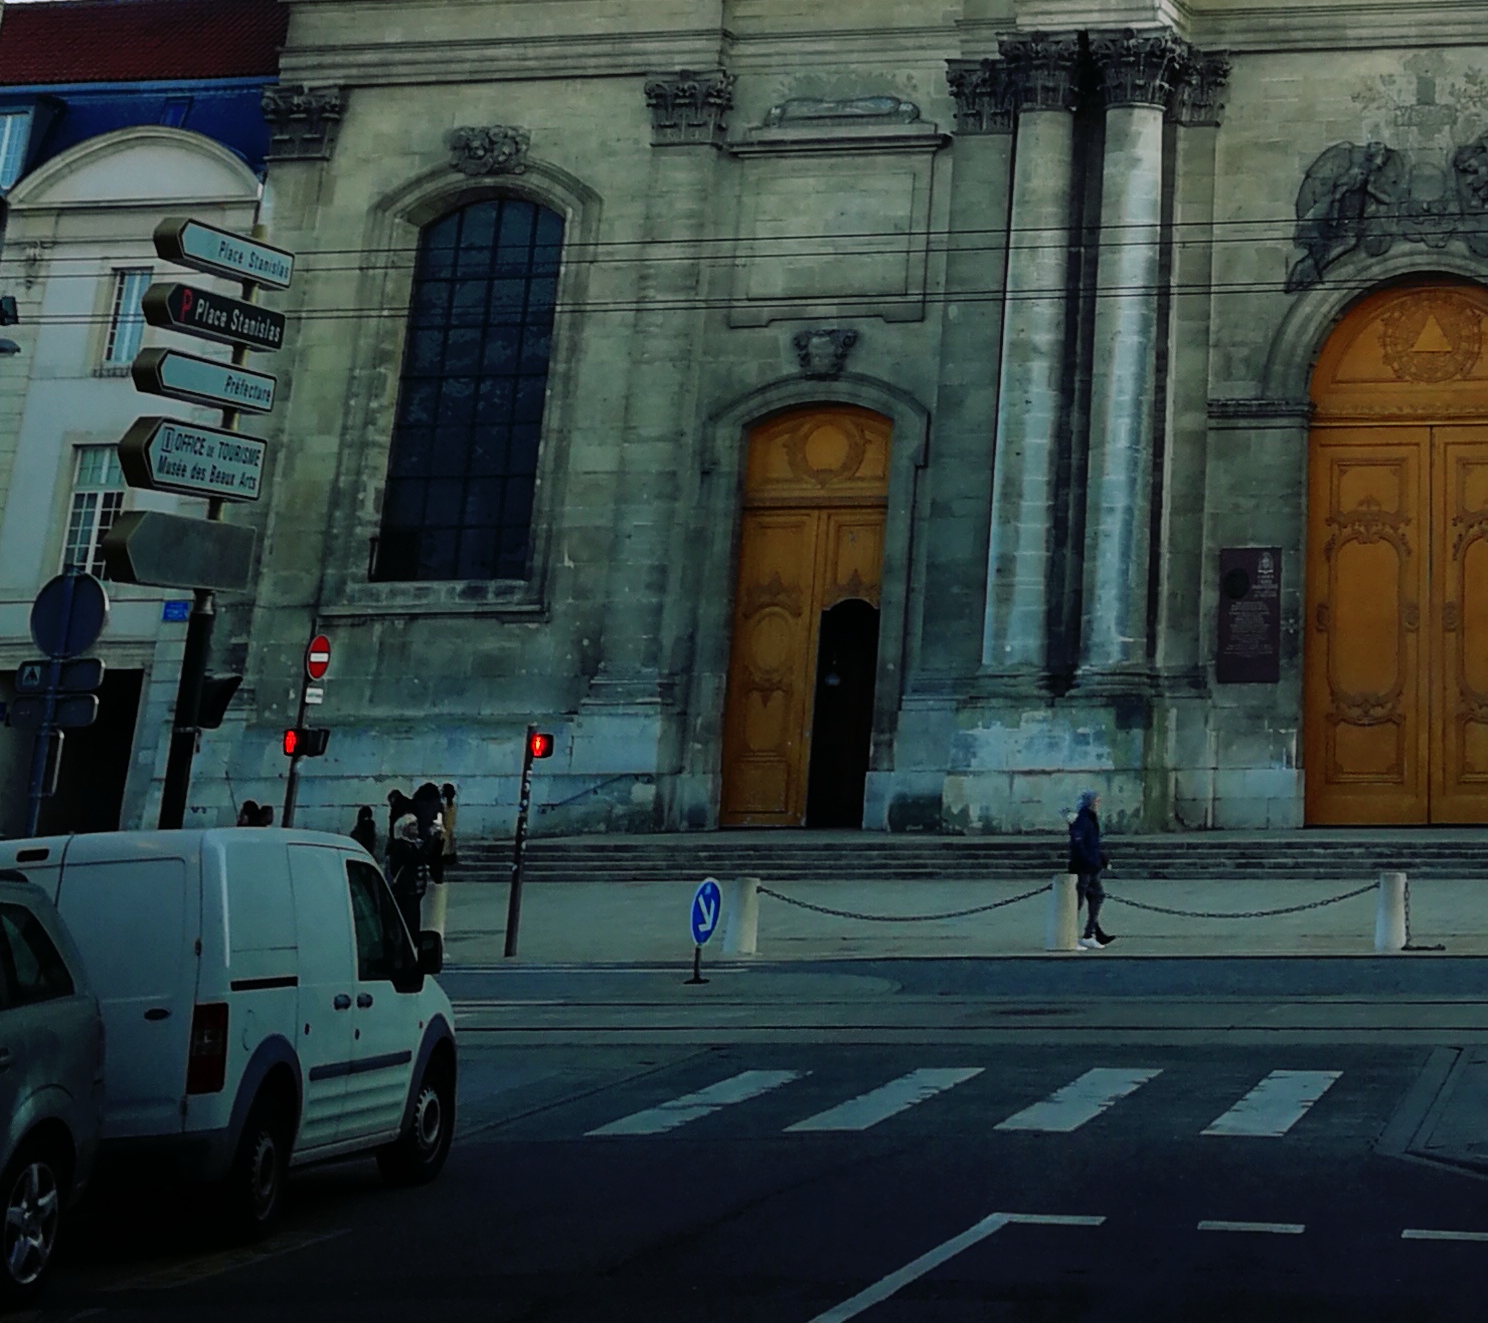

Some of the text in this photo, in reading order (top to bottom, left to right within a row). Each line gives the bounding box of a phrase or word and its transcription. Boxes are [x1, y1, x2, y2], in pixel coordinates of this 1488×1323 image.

[218, 240, 290, 280] Place Stanislas
[194, 297, 228, 329] Place
[230, 309, 281, 343] Stanislas
[223, 373, 271, 405] Préfecture
[174, 432, 207, 457] OFFICE
[217, 440, 261, 468] TOURISME
[157, 454, 257, 491] Musée des Beaux Arts
